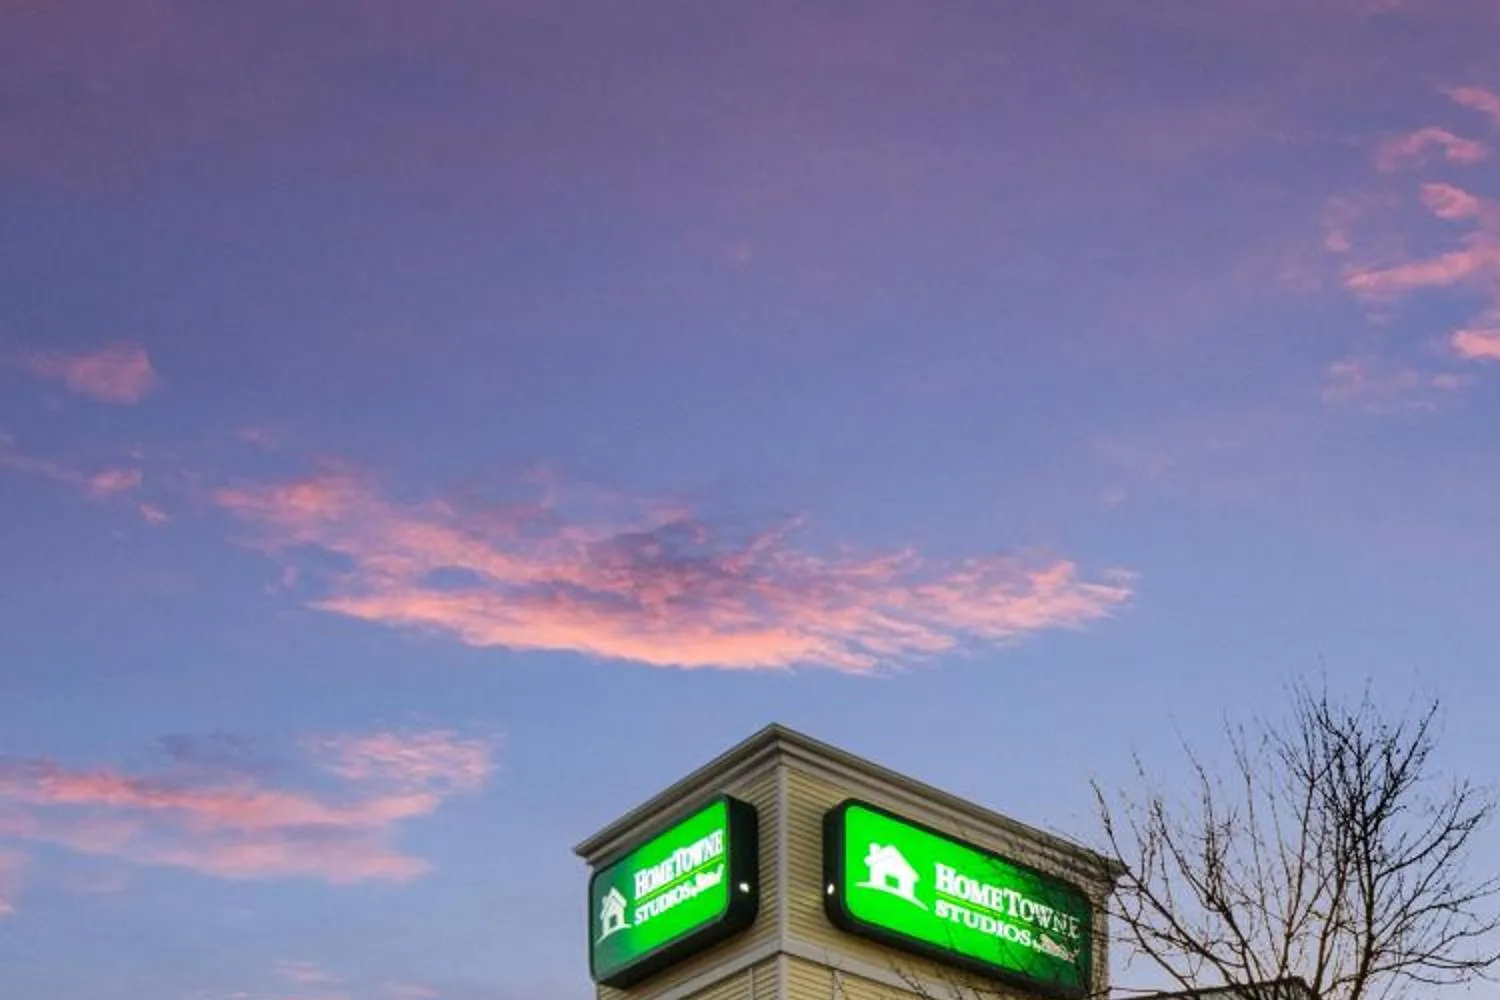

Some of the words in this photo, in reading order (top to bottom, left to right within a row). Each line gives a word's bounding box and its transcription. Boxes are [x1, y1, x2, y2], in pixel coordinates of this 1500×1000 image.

[634, 881, 692, 926] STUDIOS
[935, 862, 1080, 939] HOMETOWNE
[935, 899, 1031, 948] STUDIOS
